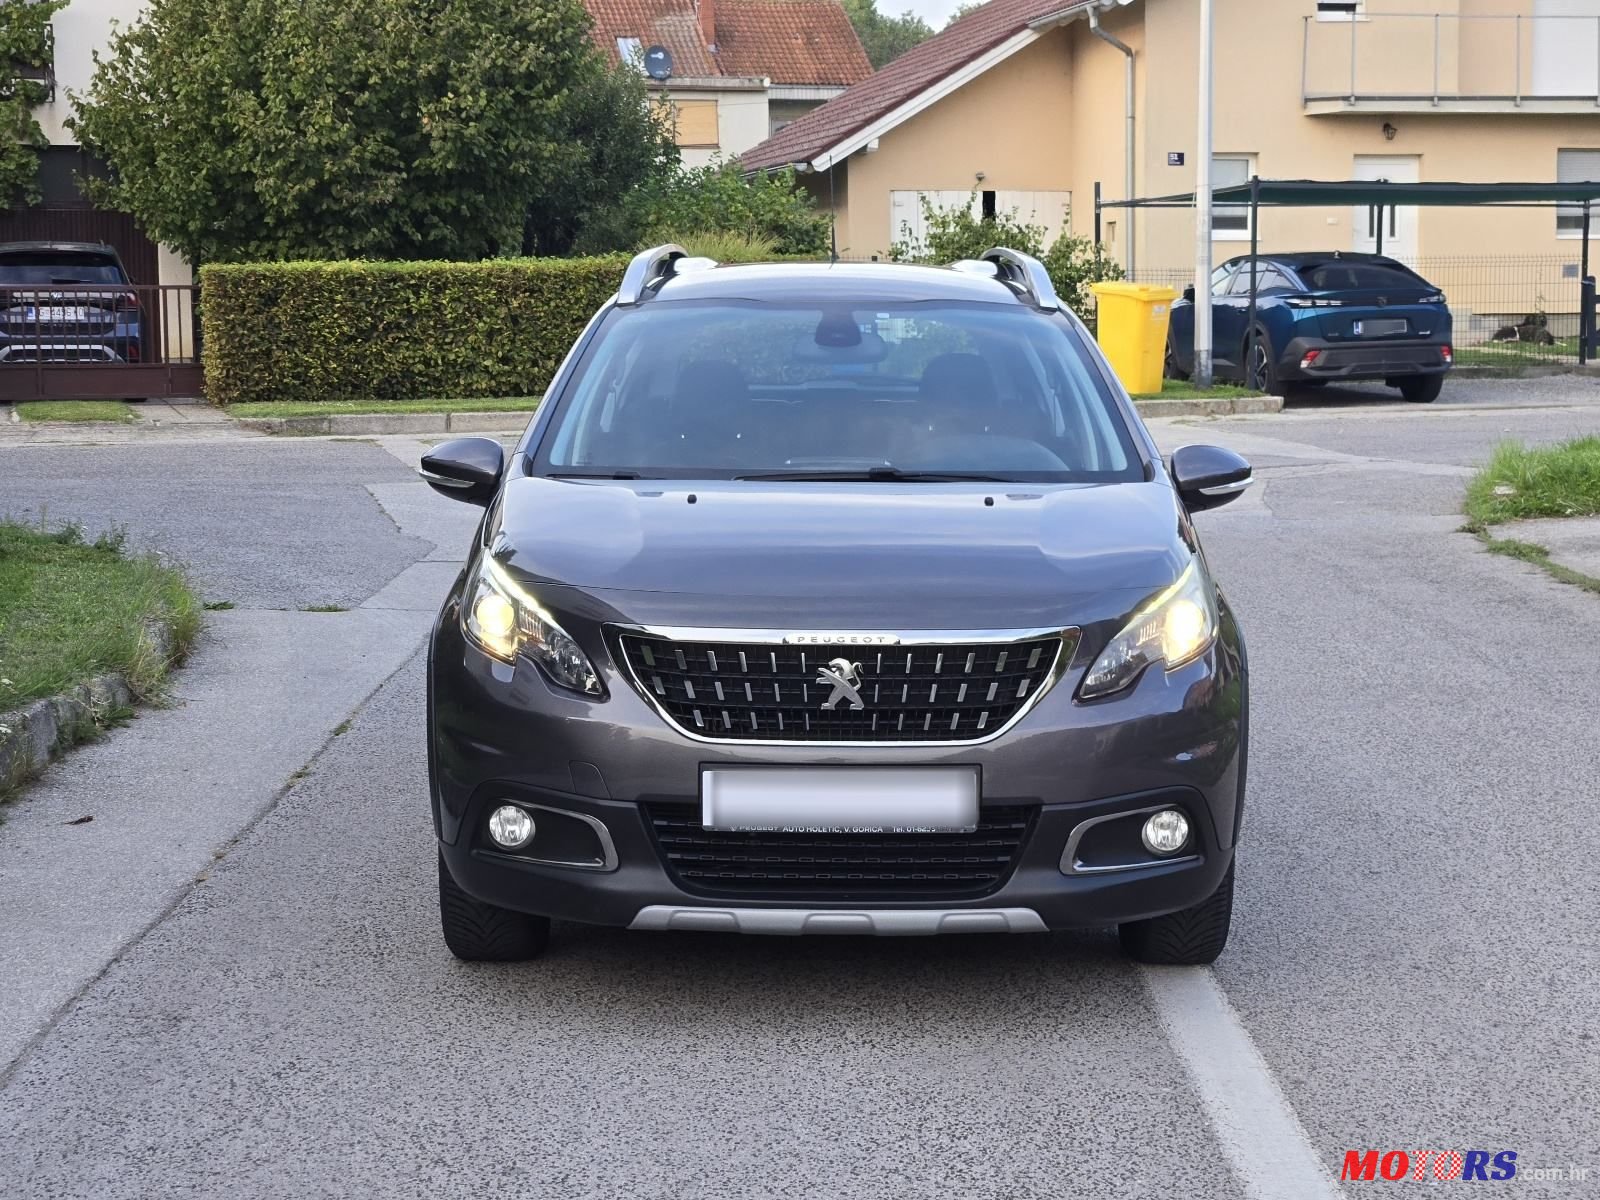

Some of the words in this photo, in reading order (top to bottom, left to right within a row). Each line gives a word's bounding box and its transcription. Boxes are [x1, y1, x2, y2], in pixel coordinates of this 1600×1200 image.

[782, 825, 805, 833] AUTO
[852, 825, 884, 833] GORICA
[892, 825, 905, 833] Tel.
